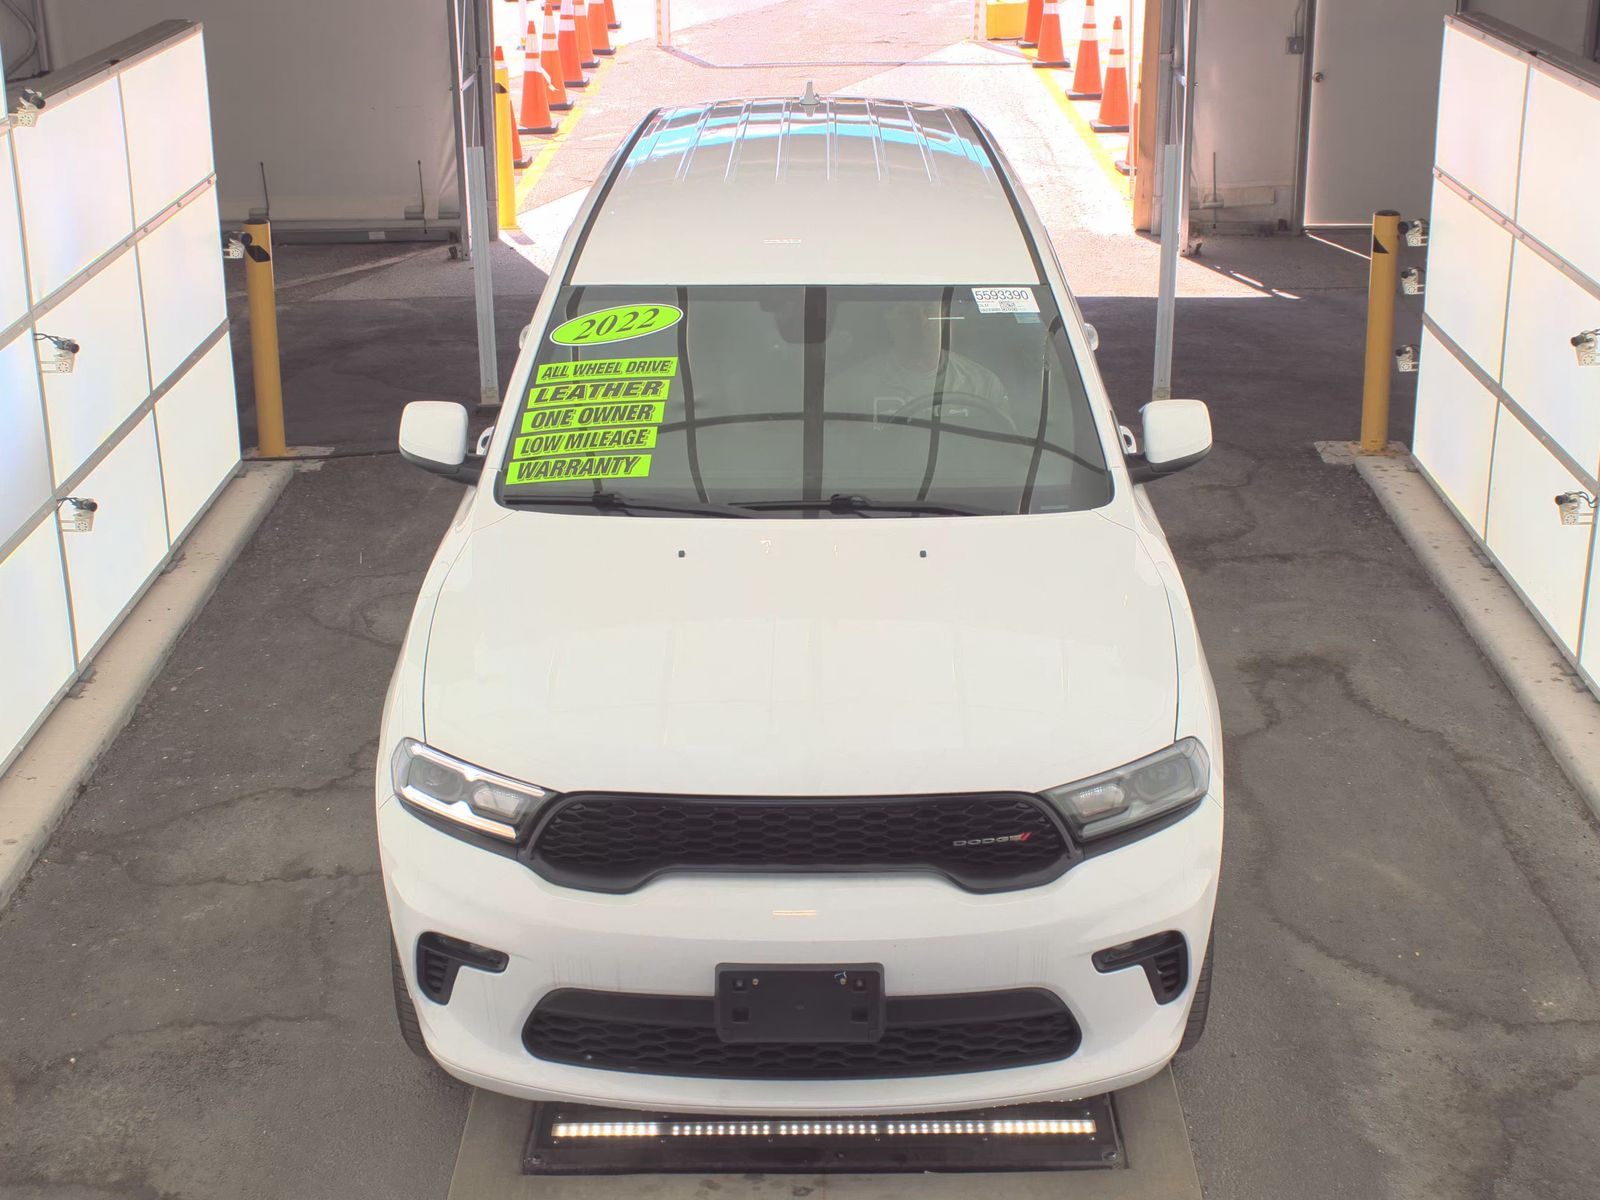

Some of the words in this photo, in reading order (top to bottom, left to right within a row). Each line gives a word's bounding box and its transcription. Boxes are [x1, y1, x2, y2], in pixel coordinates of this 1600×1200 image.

[975, 290, 1029, 300] 5593390
[572, 308, 660, 341] 2022
[541, 366, 569, 381] ALL
[572, 362, 623, 376] WHEEL
[625, 359, 673, 373] DRIVE
[534, 380, 665, 404] LEATHER
[530, 408, 578, 430] ONE
[577, 404, 655, 426] OWNER
[520, 434, 564, 456] LOW
[563, 429, 651, 451] MILEAGE
[516, 456, 641, 482] WARRANTY
[953, 835, 1021, 847] DODGE
